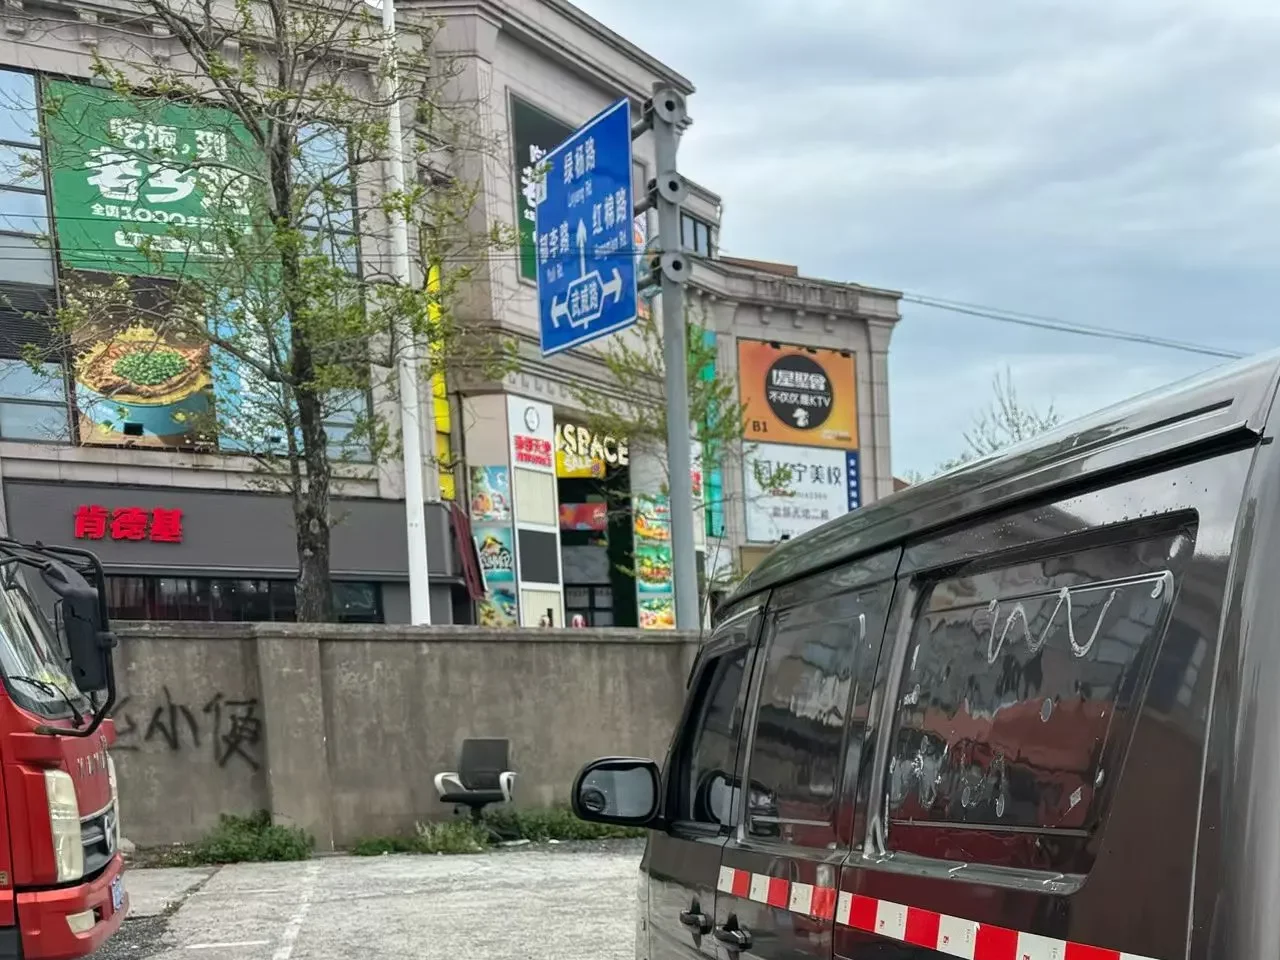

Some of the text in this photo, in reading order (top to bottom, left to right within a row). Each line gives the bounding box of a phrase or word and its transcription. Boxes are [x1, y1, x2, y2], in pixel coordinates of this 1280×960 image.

[752, 420, 768, 433] B1
[74, 504, 183, 543] 肯德基
